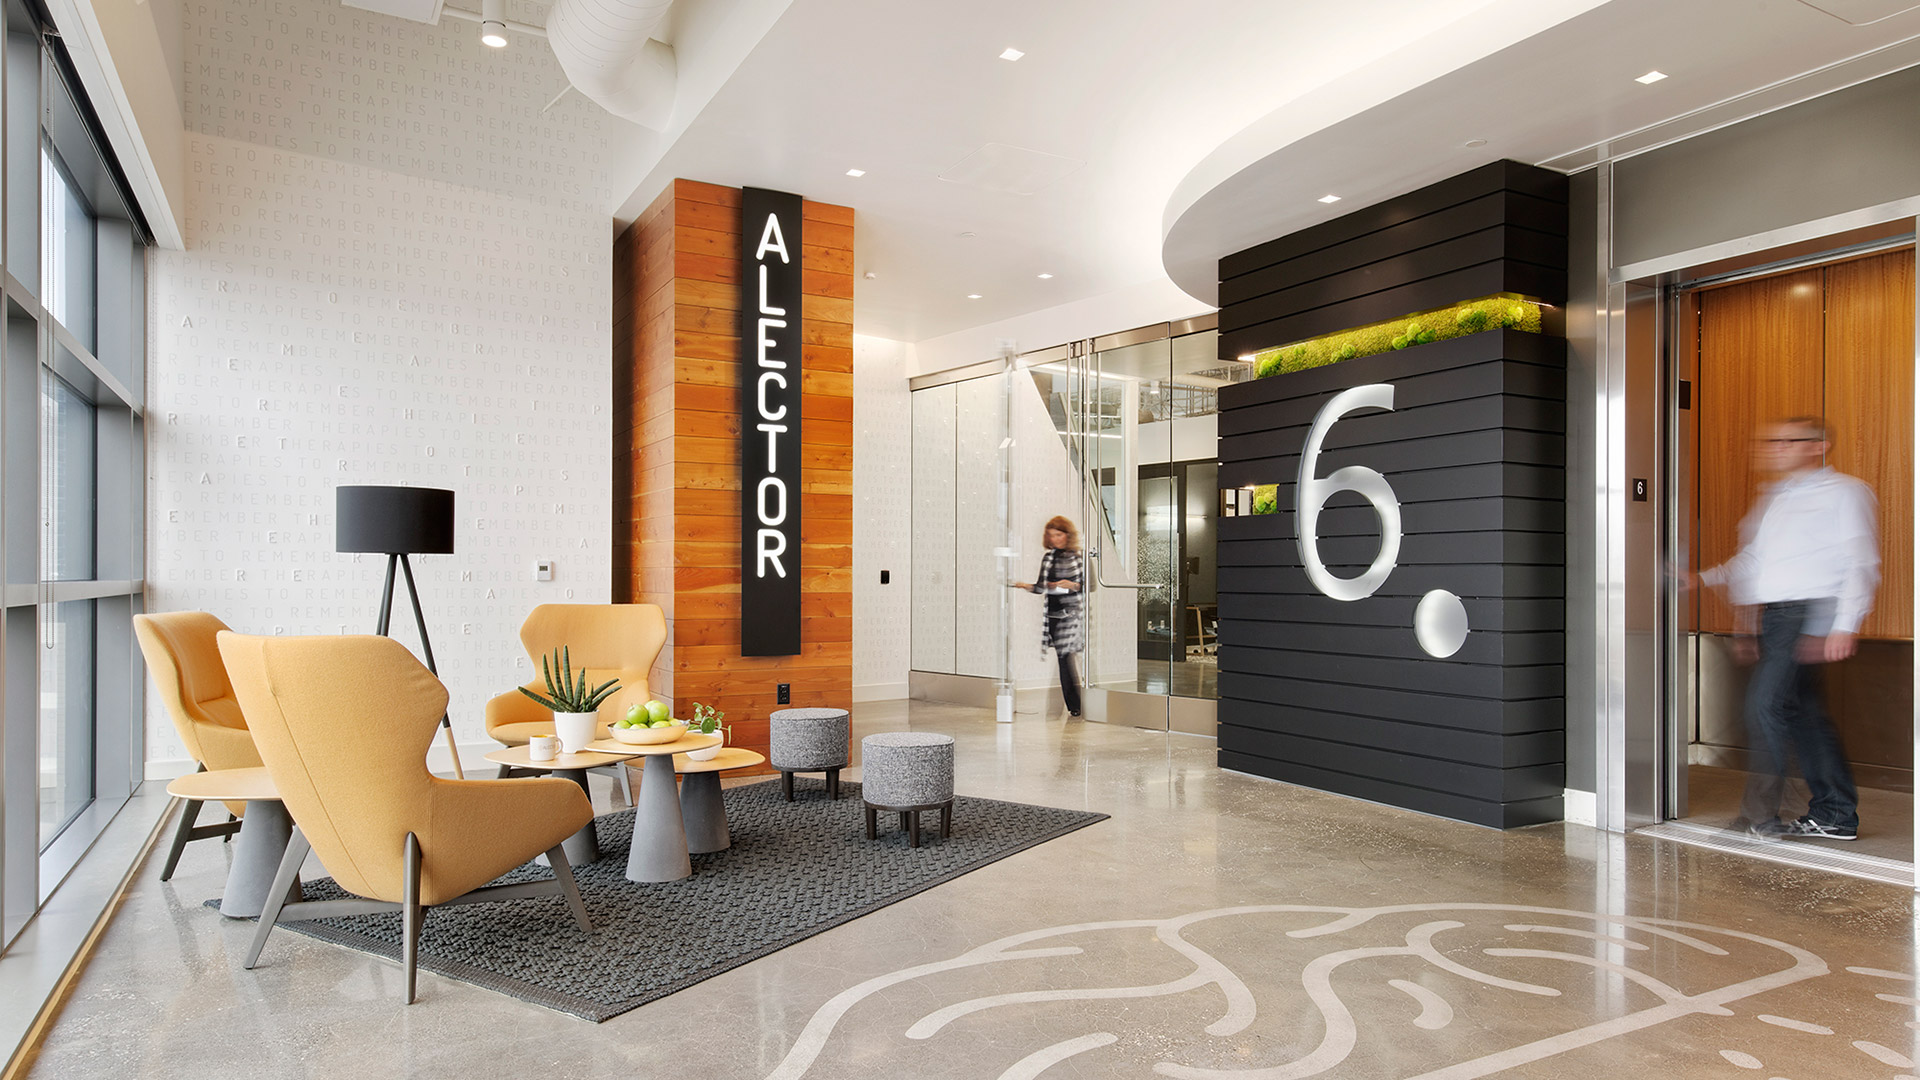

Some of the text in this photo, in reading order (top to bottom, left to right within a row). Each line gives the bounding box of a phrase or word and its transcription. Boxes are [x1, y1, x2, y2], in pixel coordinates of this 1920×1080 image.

[312, 9, 335, 25] TO
[248, 34, 272, 50] TO
[420, 68, 529, 100] THERAPIES
[264, 18, 288, 34] TO
[305, 26, 418, 61] REMEMBER
[434, 53, 542, 86] THERAPIES
[337, 70, 360, 86] TO
[376, 78, 483, 109] REMEMBER
[297, 100, 320, 115] TO
[337, 107, 447, 138] REMEMBER
[463, 130, 568, 159] THERAPIES
[581, 151, 600, 164] TO
[307, 83, 426, 116] THERAPIES
[440, 108, 460, 122] TO
[476, 114, 575, 143] REMEMBER
[308, 120, 426, 152] THERAPIES
[440, 143, 461, 158] TO
[476, 150, 575, 177] REMEMBER
[312, 140, 335, 155] TO
[352, 147, 461, 175] REMEMBER
[477, 167, 581, 195] THERAPIES
[230, 146, 254, 161] TO
[272, 152, 388, 182] REMEMBER
[404, 173, 514, 201] THERAPIES
[527, 193, 547, 206] TO
[251, 168, 374, 198] THERAPIES
[388, 189, 410, 203] TO
[426, 195, 529, 221] REMEMBER
[194, 179, 322, 209] THERAPIES
[338, 200, 360, 214] TO
[376, 205, 484, 231] REMEMBER
[499, 223, 601, 248] THERAPIES
[213, 201, 238, 216] TO
[256, 207, 373, 234] REMEMBER
[390, 225, 501, 251] THERAPIES
[514, 242, 534, 256] TO
[297, 231, 320, 246] TO
[337, 237, 447, 262] REMEMBER
[463, 253, 568, 277] THERAPIES
[581, 268, 600, 281] TO
[307, 251, 426, 277] THERAPIES
[440, 268, 460, 281] TO
[476, 272, 575, 295] REMEMBER
[167, 273, 297, 299] THERAPIES
[313, 289, 336, 303] TO
[352, 294, 461, 316] REMEMBER
[477, 308, 581, 329] THERAPIES
[249, 263, 273, 278] TO
[290, 268, 404, 292] REMEMBER
[421, 283, 529, 306] THERAPIES
[542, 298, 561, 310] TO
[194, 296, 322, 320] THERAPIES
[338, 311, 360, 324] TO
[376, 315, 484, 336] REMEMBER
[499, 327, 601, 348] THERAPIES
[264, 322, 288, 336] TO
[305, 326, 418, 348] REMEMBER
[434, 338, 542, 359] THERAPIES
[555, 350, 574, 362] TO
[171, 333, 197, 347] TO
[215, 337, 336, 359] REMEMBER
[353, 349, 467, 370] THERAPIES
[481, 360, 501, 373] TO
[194, 354, 322, 376] THERAPIES
[337, 366, 360, 379] TO
[376, 369, 483, 389] REMEMBER
[498, 379, 601, 398] THERAPIES
[235, 377, 360, 398] THERAPIES
[374, 387, 396, 400] TO
[412, 390, 516, 409] REMEMBER
[755, 212, 790, 578] ALECTOR
[164, 411, 289, 430] REMEMBER
[307, 420, 425, 438] THERAPIES
[439, 428, 460, 440] TO
[475, 430, 574, 446] REMEMBER
[214, 395, 239, 408] TO
[257, 398, 374, 417] REMEMBER
[390, 407, 502, 425] THERAPIES
[515, 415, 534, 427] TO
[277, 437, 398, 454] THERAPIES
[412, 444, 433, 456] TO
[449, 446, 550, 462] REMEMBER
[297, 457, 320, 469] TO
[337, 459, 447, 475] REMEMBER
[463, 465, 568, 480] THERAPIES
[581, 470, 600, 481] TO
[199, 491, 321, 506] REMEMBER
[468, 500, 488, 511] TO
[503, 501, 600, 515] REMEMBER
[282, 475, 305, 487] TO
[569, 486, 588, 498] TO
[1637, 481, 1643, 495] 6
[464, 518, 564, 530] REMEMBER
[198, 549, 223, 562] TO
[502, 553, 522, 564] TO
[260, 569, 537, 581] THERAPIES REMEMBER
[248, 607, 272, 619] TO
[263, 588, 287, 600] TO
[434, 588, 541, 599] THERAPIES
[554, 588, 573, 598] TO
[337, 625, 360, 636] TO
[440, 659, 460, 670] TO
